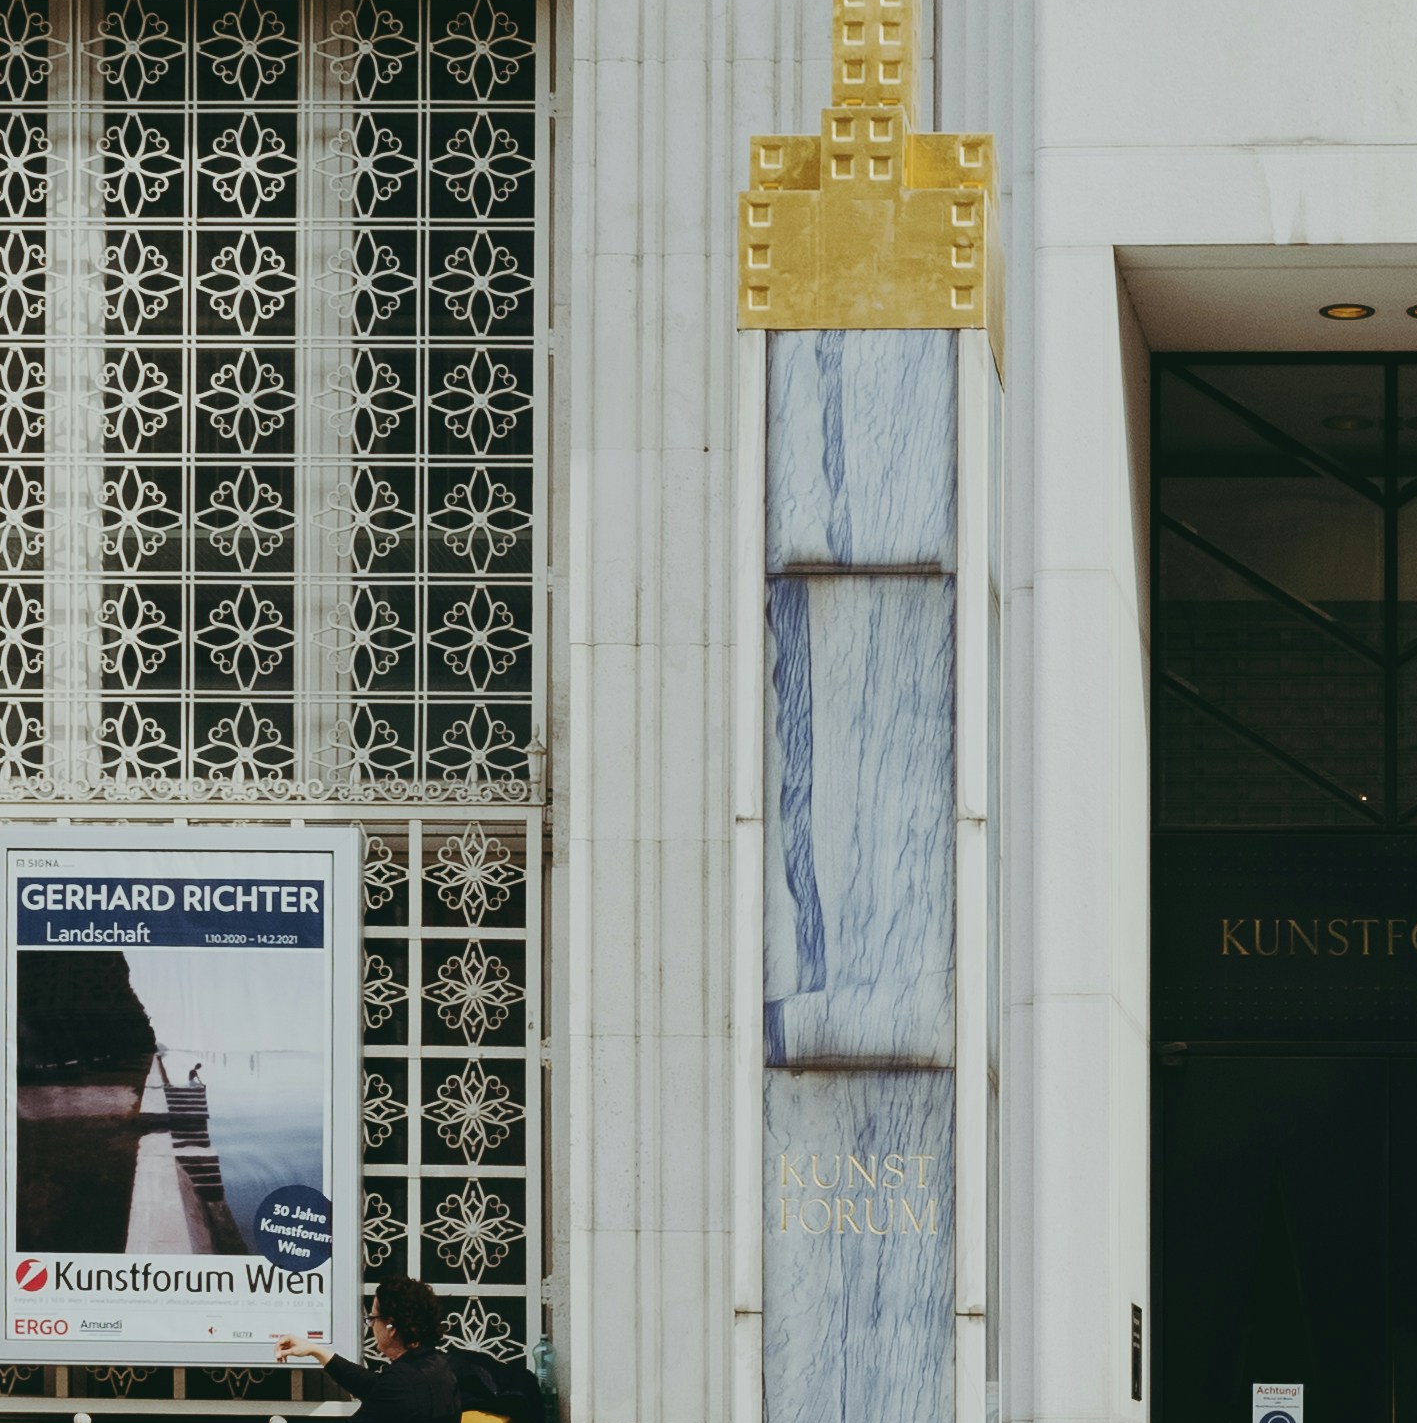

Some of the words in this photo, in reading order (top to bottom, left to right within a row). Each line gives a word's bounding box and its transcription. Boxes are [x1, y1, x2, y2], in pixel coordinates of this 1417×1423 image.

[28, 858, 60, 868] SIGNA
[20, 883, 176, 912] GERHARD
[183, 885, 320, 914] RICHTER
[46, 921, 151, 944] Landschaft
[204, 933, 247, 944] 1.10.2020
[257, 934, 298, 945] 14.2.2021
[779, 1153, 936, 1190] KUNST
[272, 1204, 290, 1217] 30
[291, 1205, 327, 1224] Jahre
[779, 1197, 939, 1235] FORUM
[260, 1217, 333, 1243] Kunstforum
[277, 1239, 311, 1258] Wien
[55, 1261, 235, 1293] Kunstforum
[246, 1263, 324, 1295] Wien
[14, 1319, 69, 1335] ERGO
[80, 1319, 123, 1330] Amundi
[1256, 1386, 1301, 1397] Achtung!
